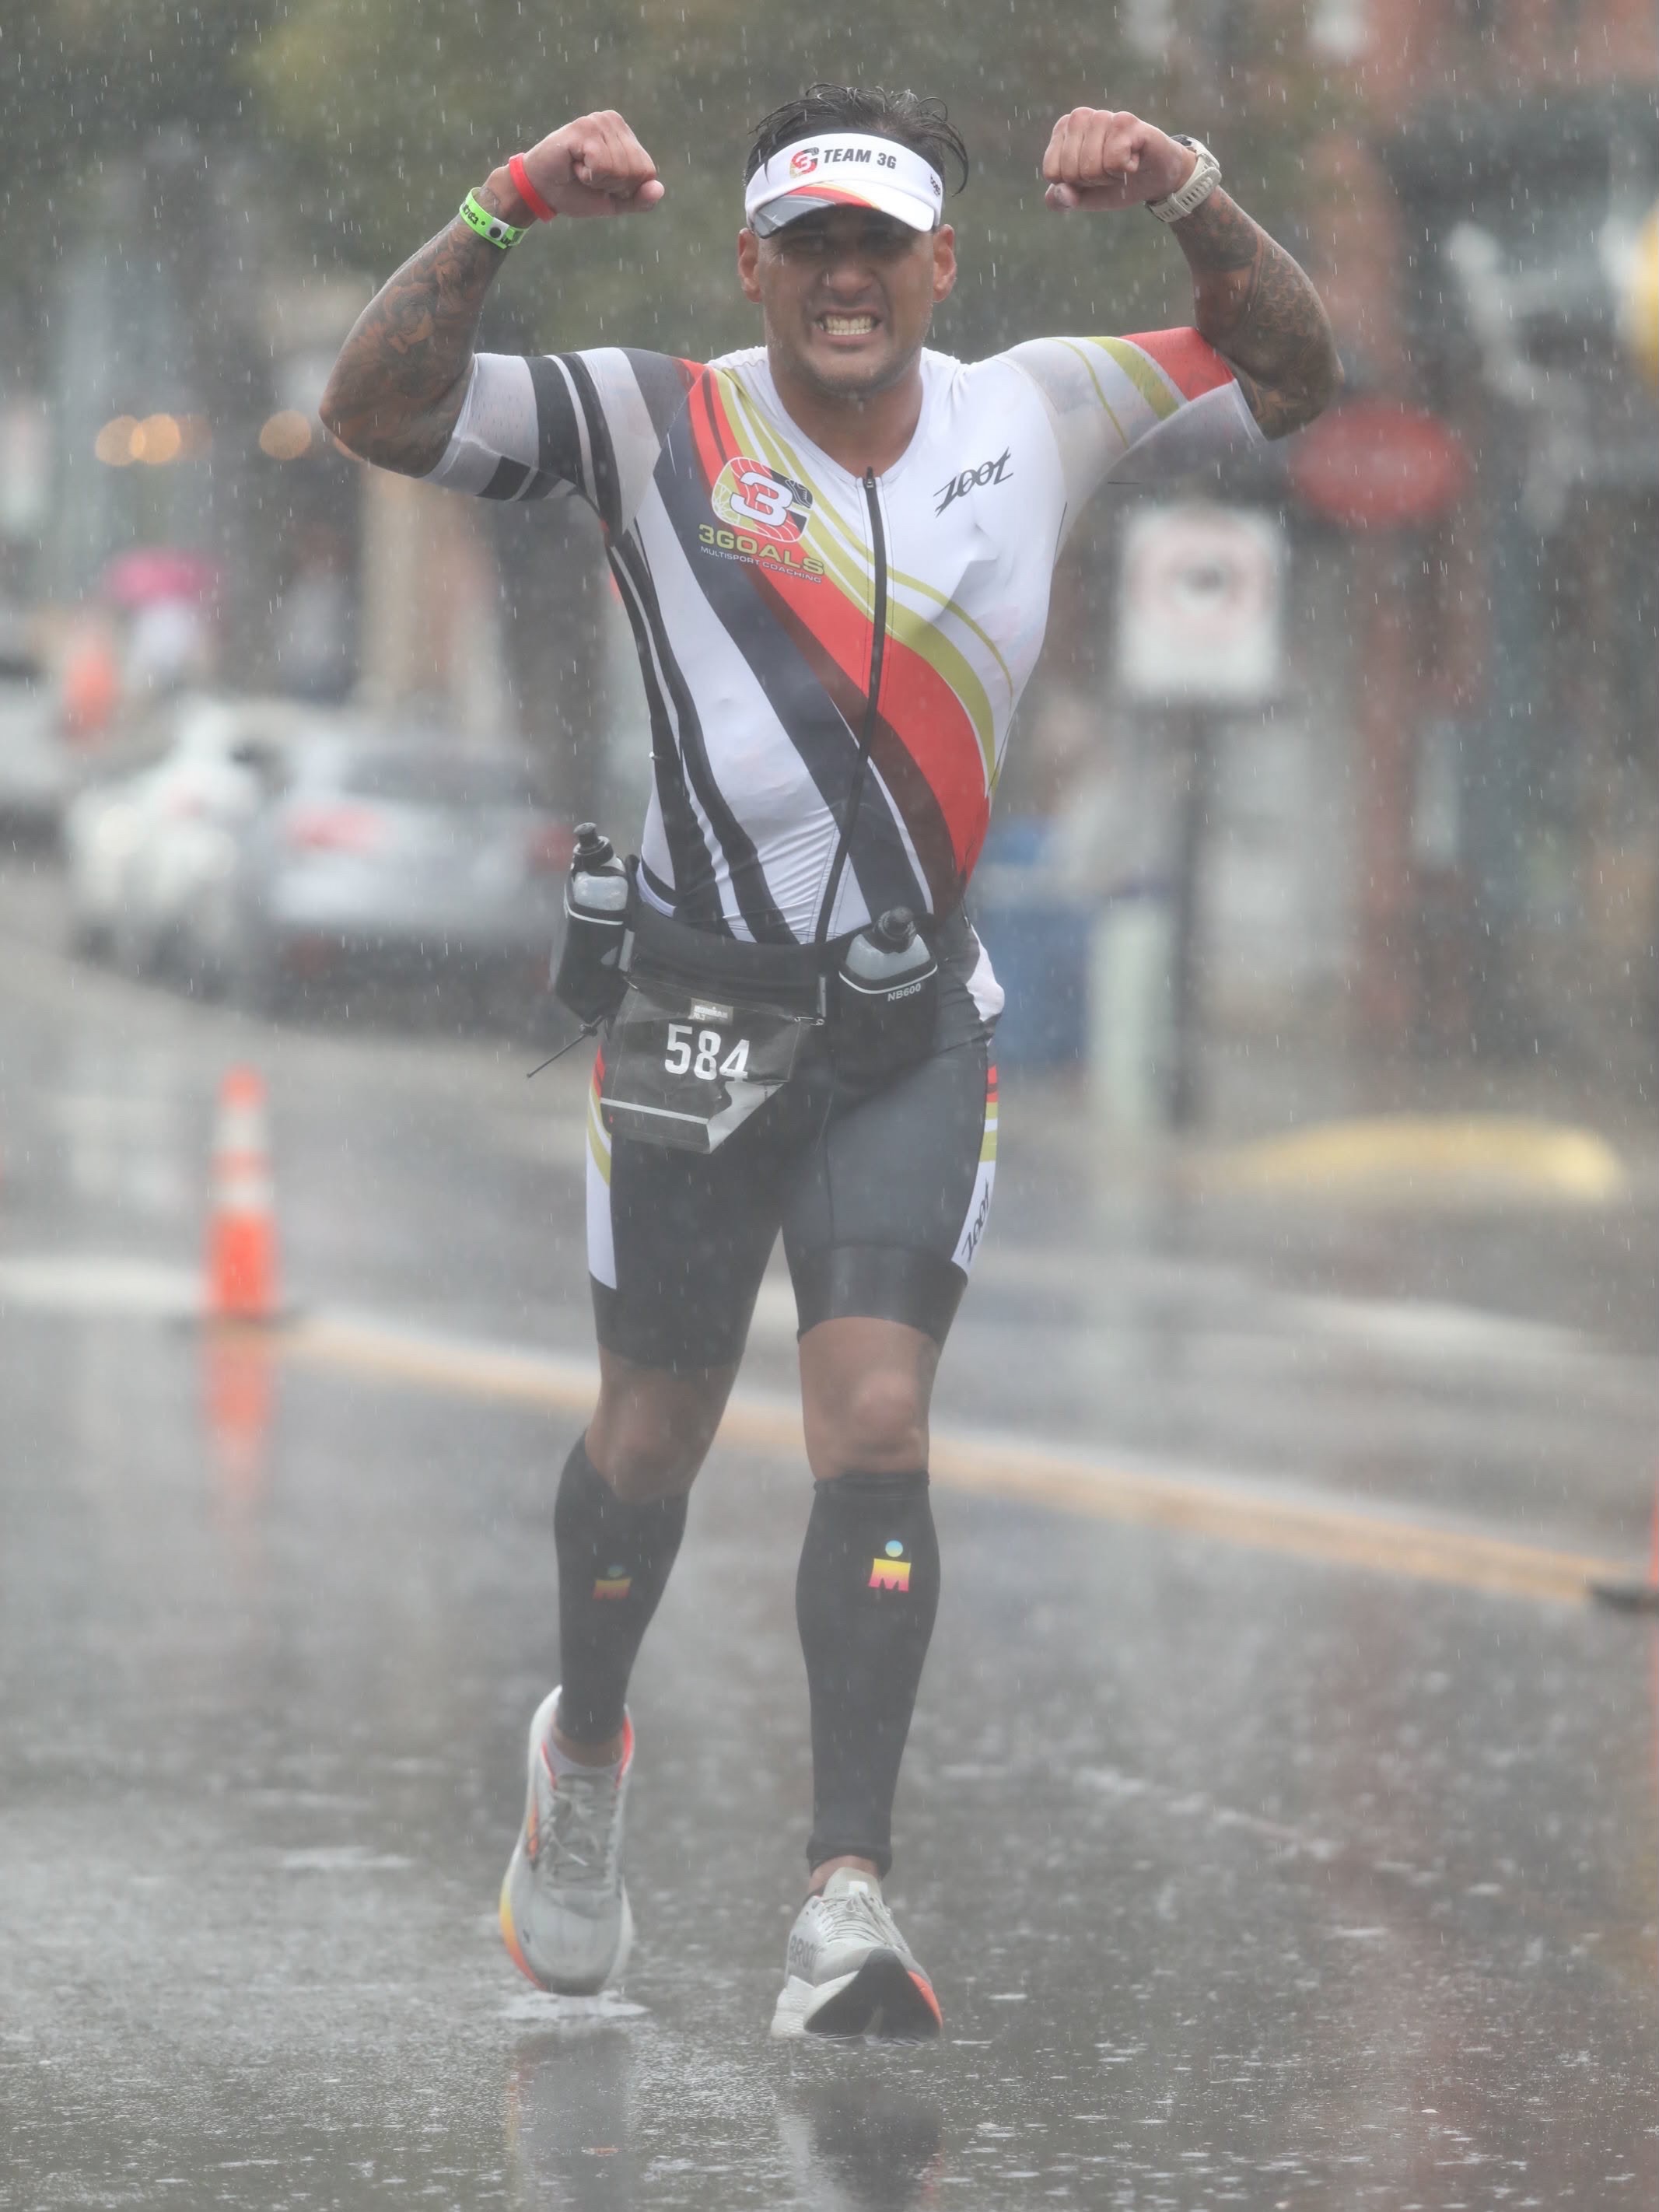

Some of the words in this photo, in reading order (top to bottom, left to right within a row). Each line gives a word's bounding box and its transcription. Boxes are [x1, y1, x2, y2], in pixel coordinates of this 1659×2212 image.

[824, 149, 872, 163] TEAM
[730, 471, 793, 527] 3
[698, 523, 825, 576] 3GOALS
[700, 545, 760, 566] MULTISPORT
[761, 561, 822, 583] COACHING
[887, 982, 922, 1002] NB600
[665, 1023, 750, 1080] 584
